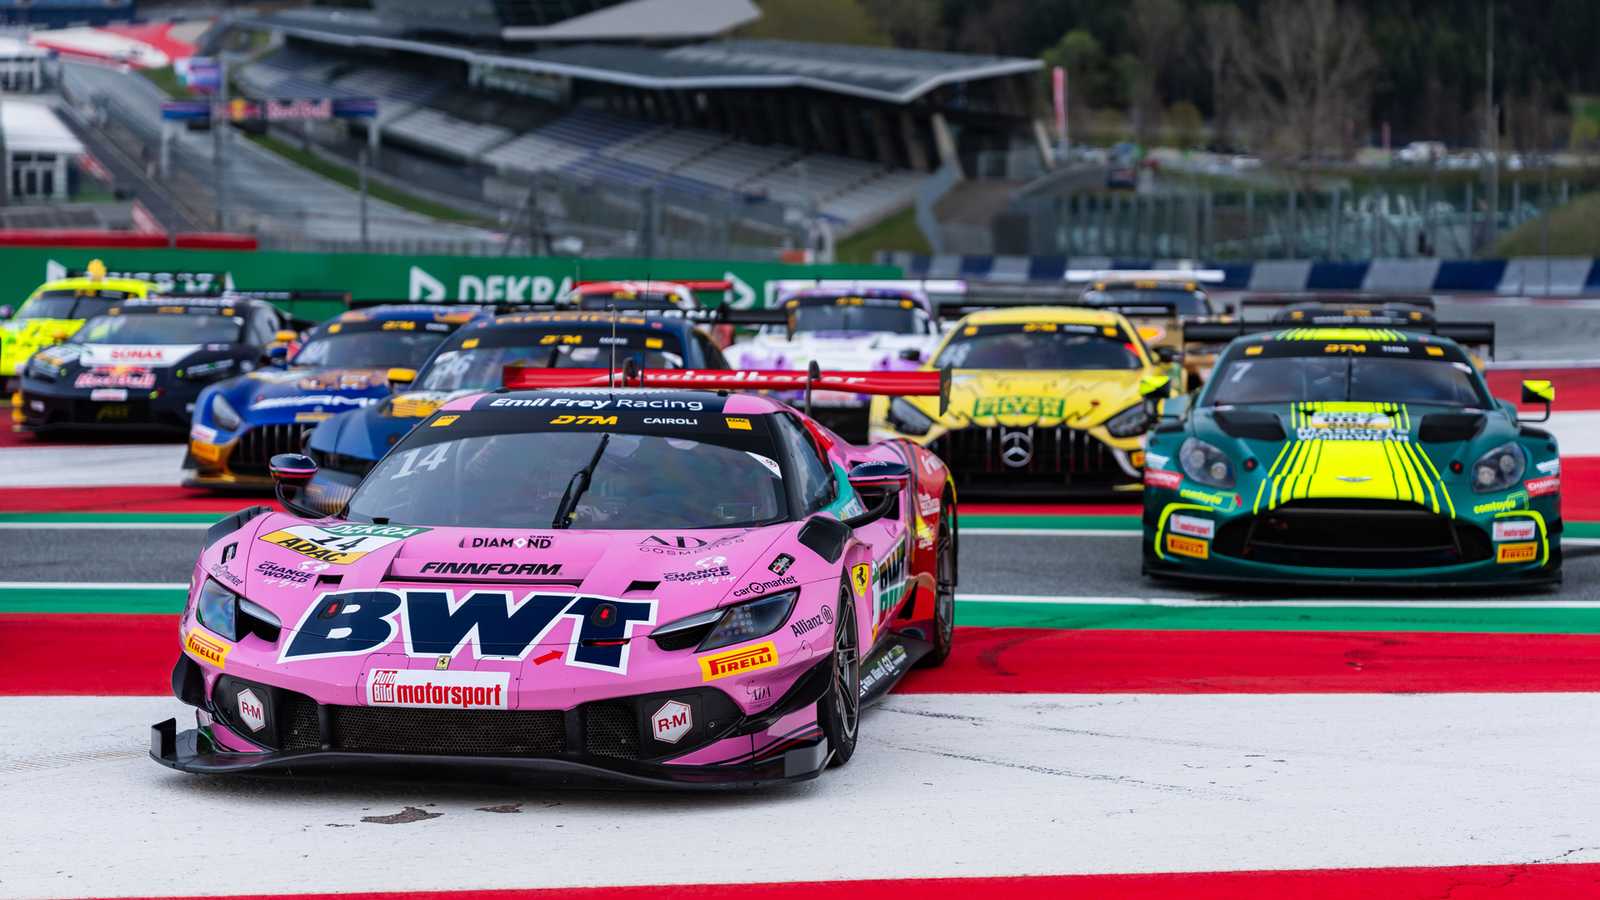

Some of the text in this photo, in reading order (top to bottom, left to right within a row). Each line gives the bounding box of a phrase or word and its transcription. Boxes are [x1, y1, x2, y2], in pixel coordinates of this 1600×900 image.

[459, 275, 577, 303] DEKRA
[489, 398, 703, 411] Emil Frey Racing
[549, 415, 618, 426] DTM
[643, 418, 698, 426] CAIROLI
[391, 442, 453, 481] 14
[328, 525, 420, 537] DEKRA
[277, 537, 348, 563] ADAC
[310, 536, 369, 551] 14
[258, 563, 315, 579] CHANGE
[420, 561, 562, 576] FINNFORM
[664, 565, 729, 580] CHANGE
[263, 571, 309, 583] WORLD
[679, 571, 731, 583] WORLD
[763, 575, 798, 590] market
[277, 588, 660, 676] BWT
[790, 614, 824, 637] Allianz
[186, 634, 226, 663] PIRELLI
[708, 647, 772, 676] PIRELLI
[375, 671, 397, 684] Auto
[374, 682, 501, 710] Bild motorsport
[241, 700, 262, 721] R-M
[658, 711, 687, 733] R-M
